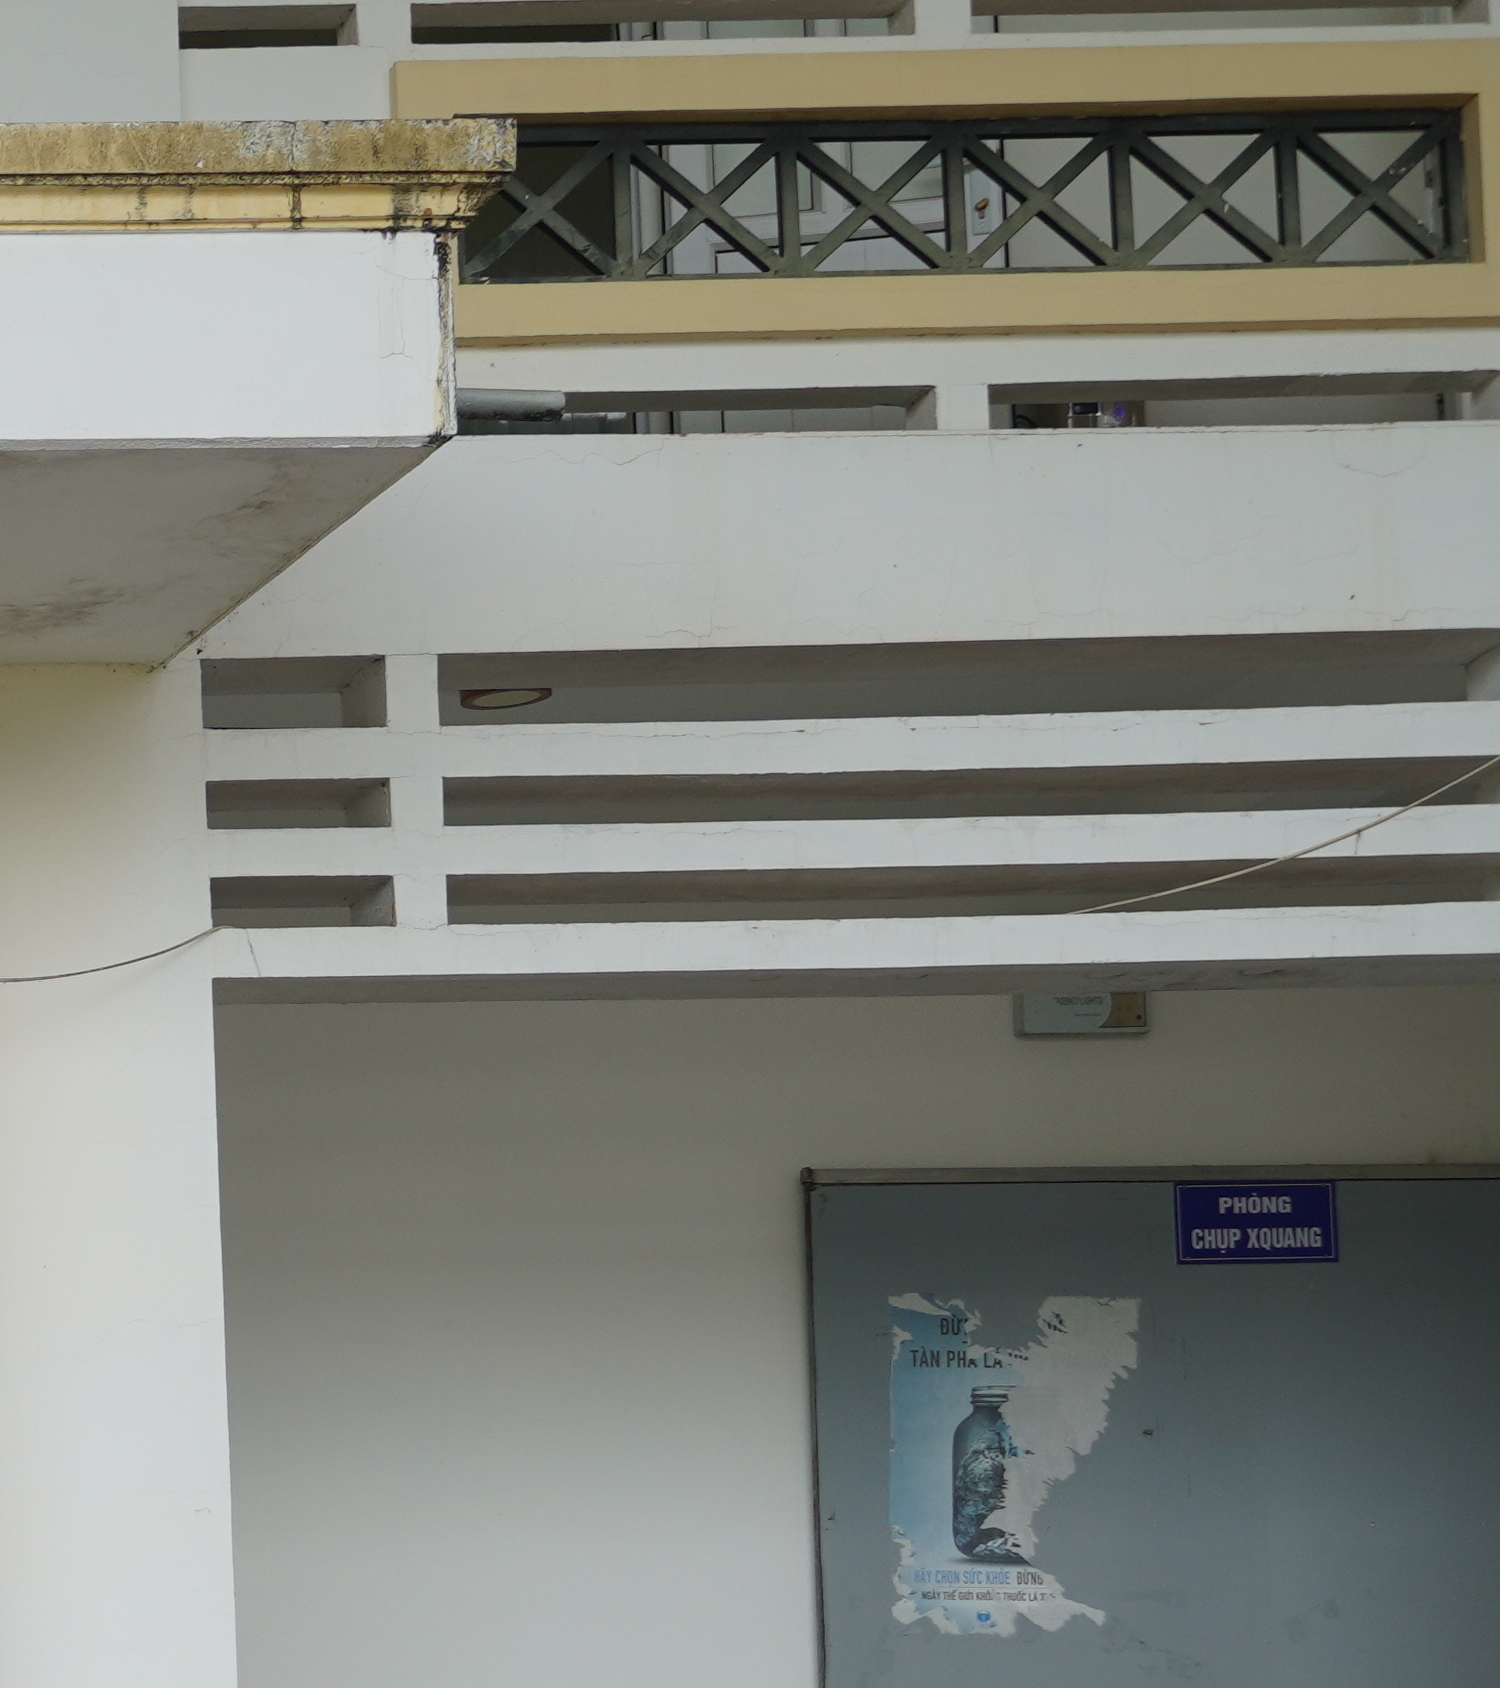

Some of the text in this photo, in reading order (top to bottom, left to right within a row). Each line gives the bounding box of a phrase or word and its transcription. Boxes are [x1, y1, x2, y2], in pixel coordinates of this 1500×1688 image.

[1219, 1192, 1292, 1214] PHÒNG
[1190, 1226, 1323, 1253] CHỤP XQUANG
[910, 1346, 940, 1367] TÀN
